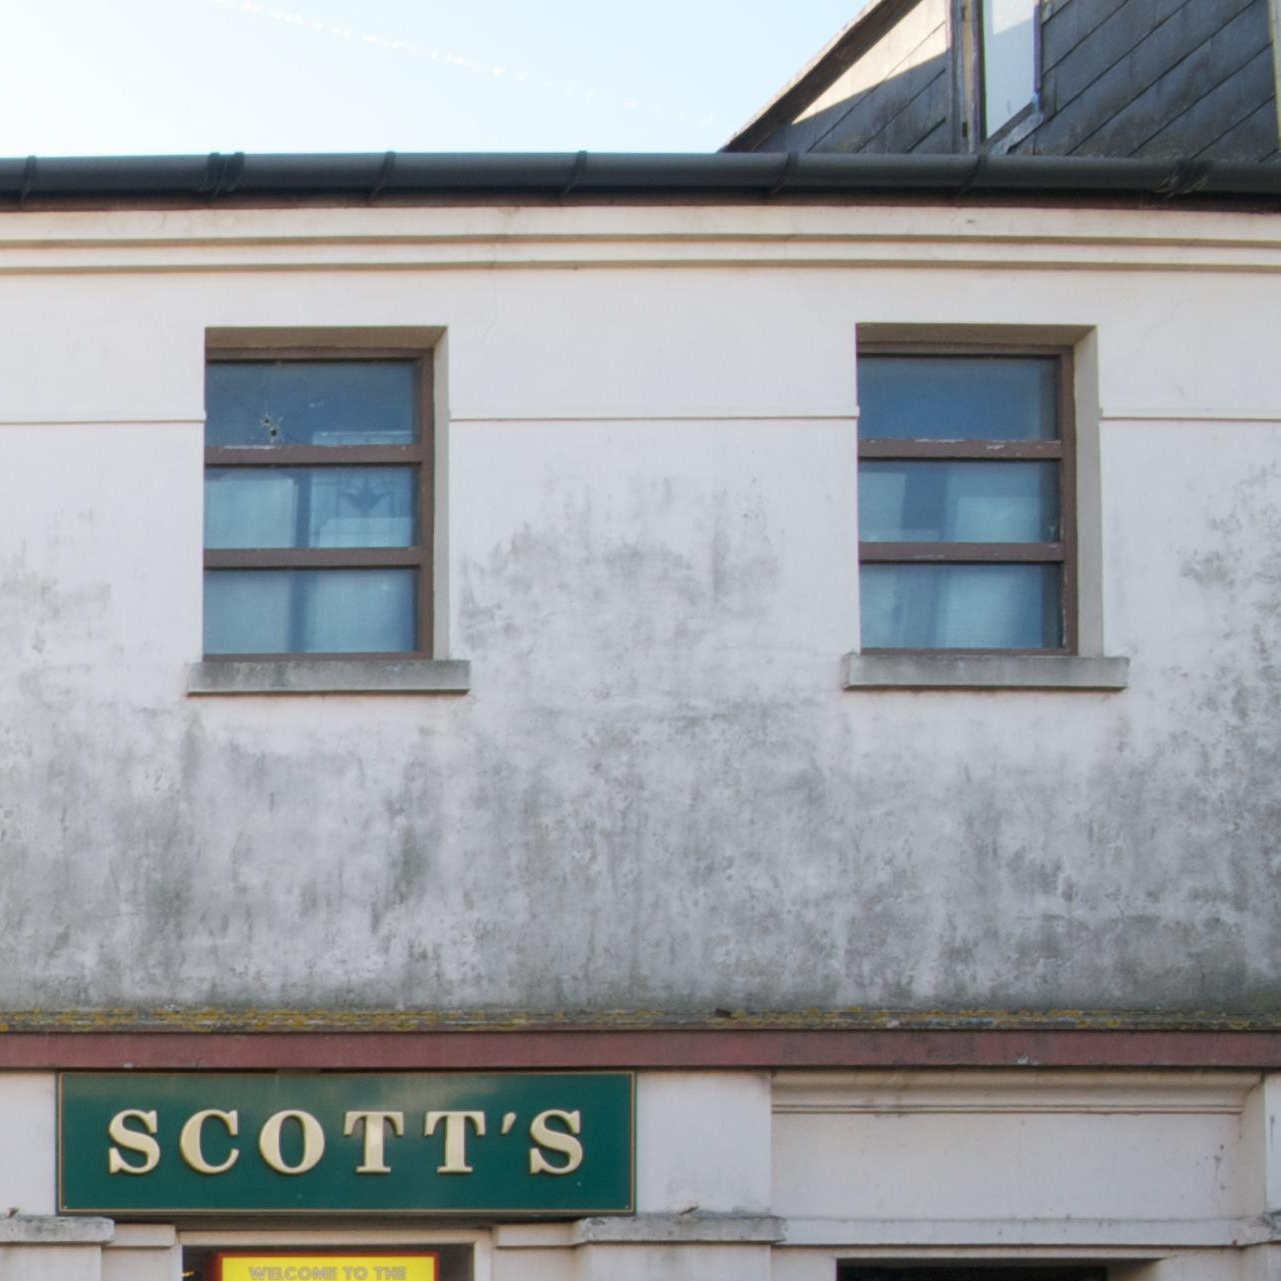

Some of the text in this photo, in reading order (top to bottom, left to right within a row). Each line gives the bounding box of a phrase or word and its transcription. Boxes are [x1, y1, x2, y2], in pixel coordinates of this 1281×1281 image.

[107, 1108, 584, 1176] SCOTT'S
[249, 1266, 407, 1281] WELCOME TO THE
